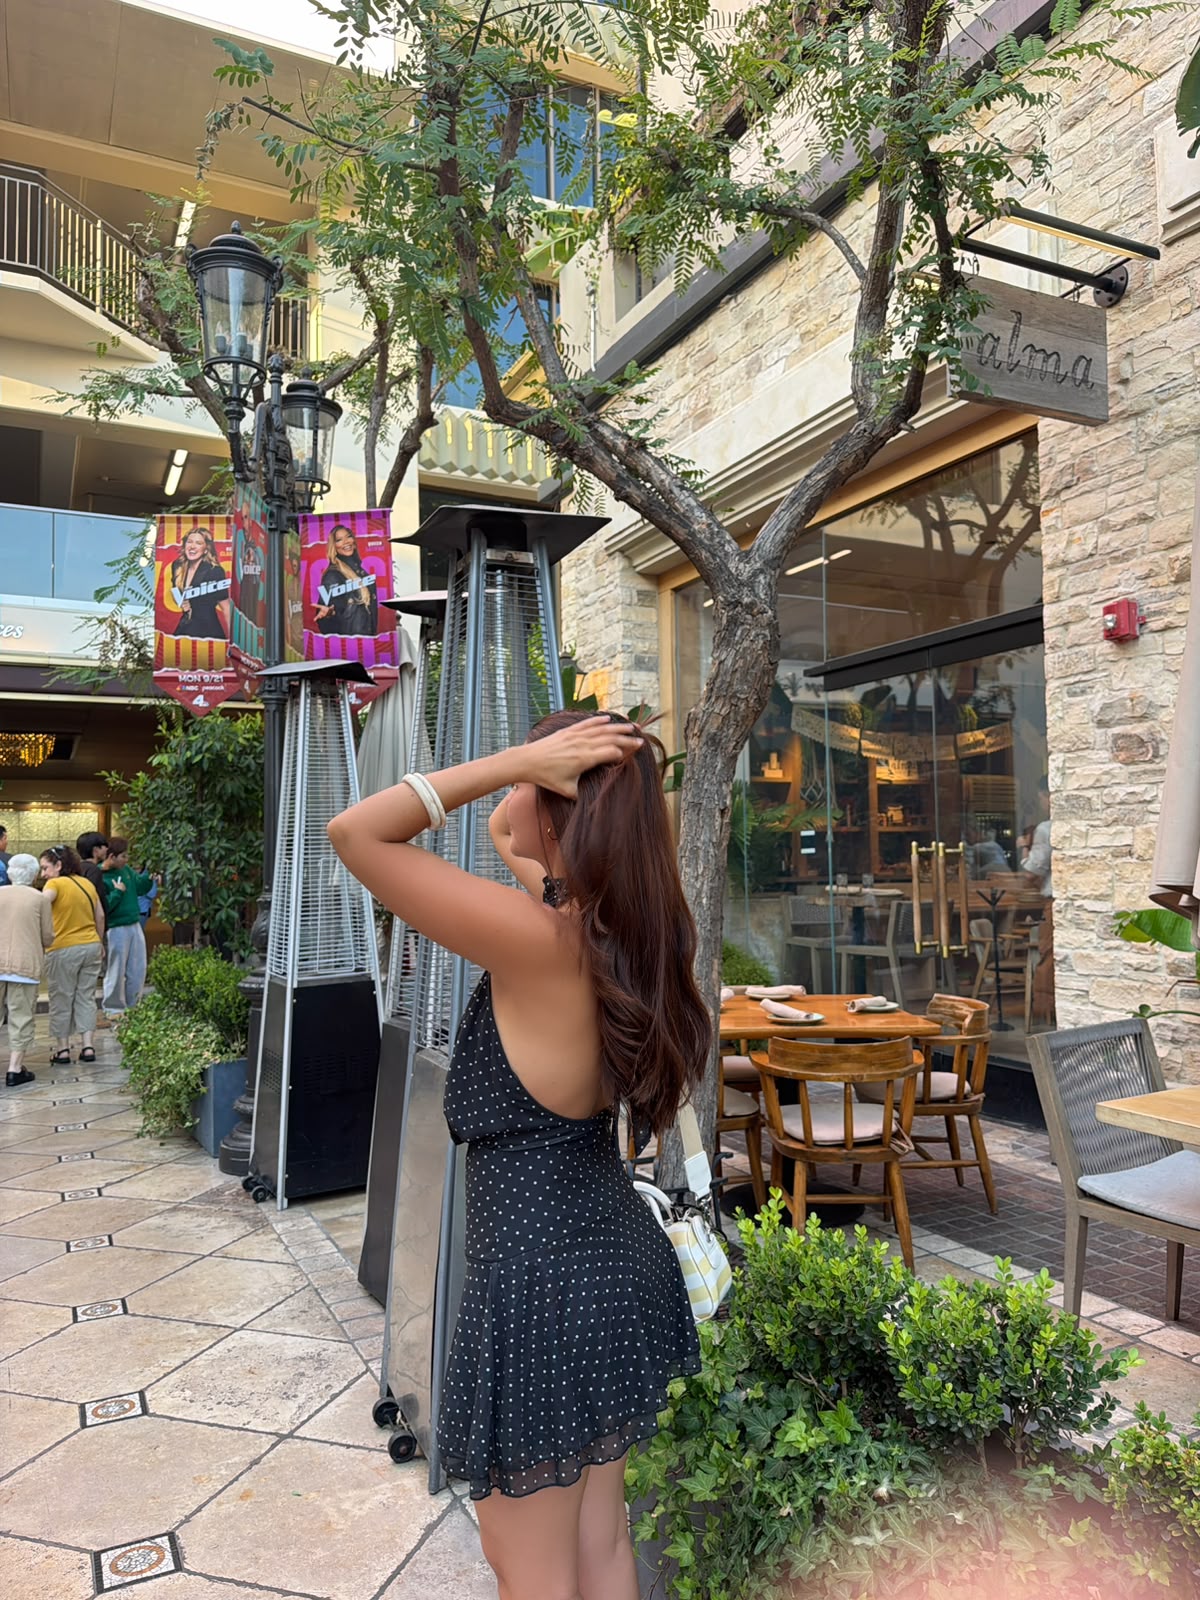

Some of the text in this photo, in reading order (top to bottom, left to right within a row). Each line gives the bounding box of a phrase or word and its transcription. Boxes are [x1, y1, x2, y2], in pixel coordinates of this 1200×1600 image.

[977, 309, 1095, 390] alma
[171, 578, 231, 608] Voice
[317, 574, 376, 607] Voice
[178, 674, 200, 683] MON
